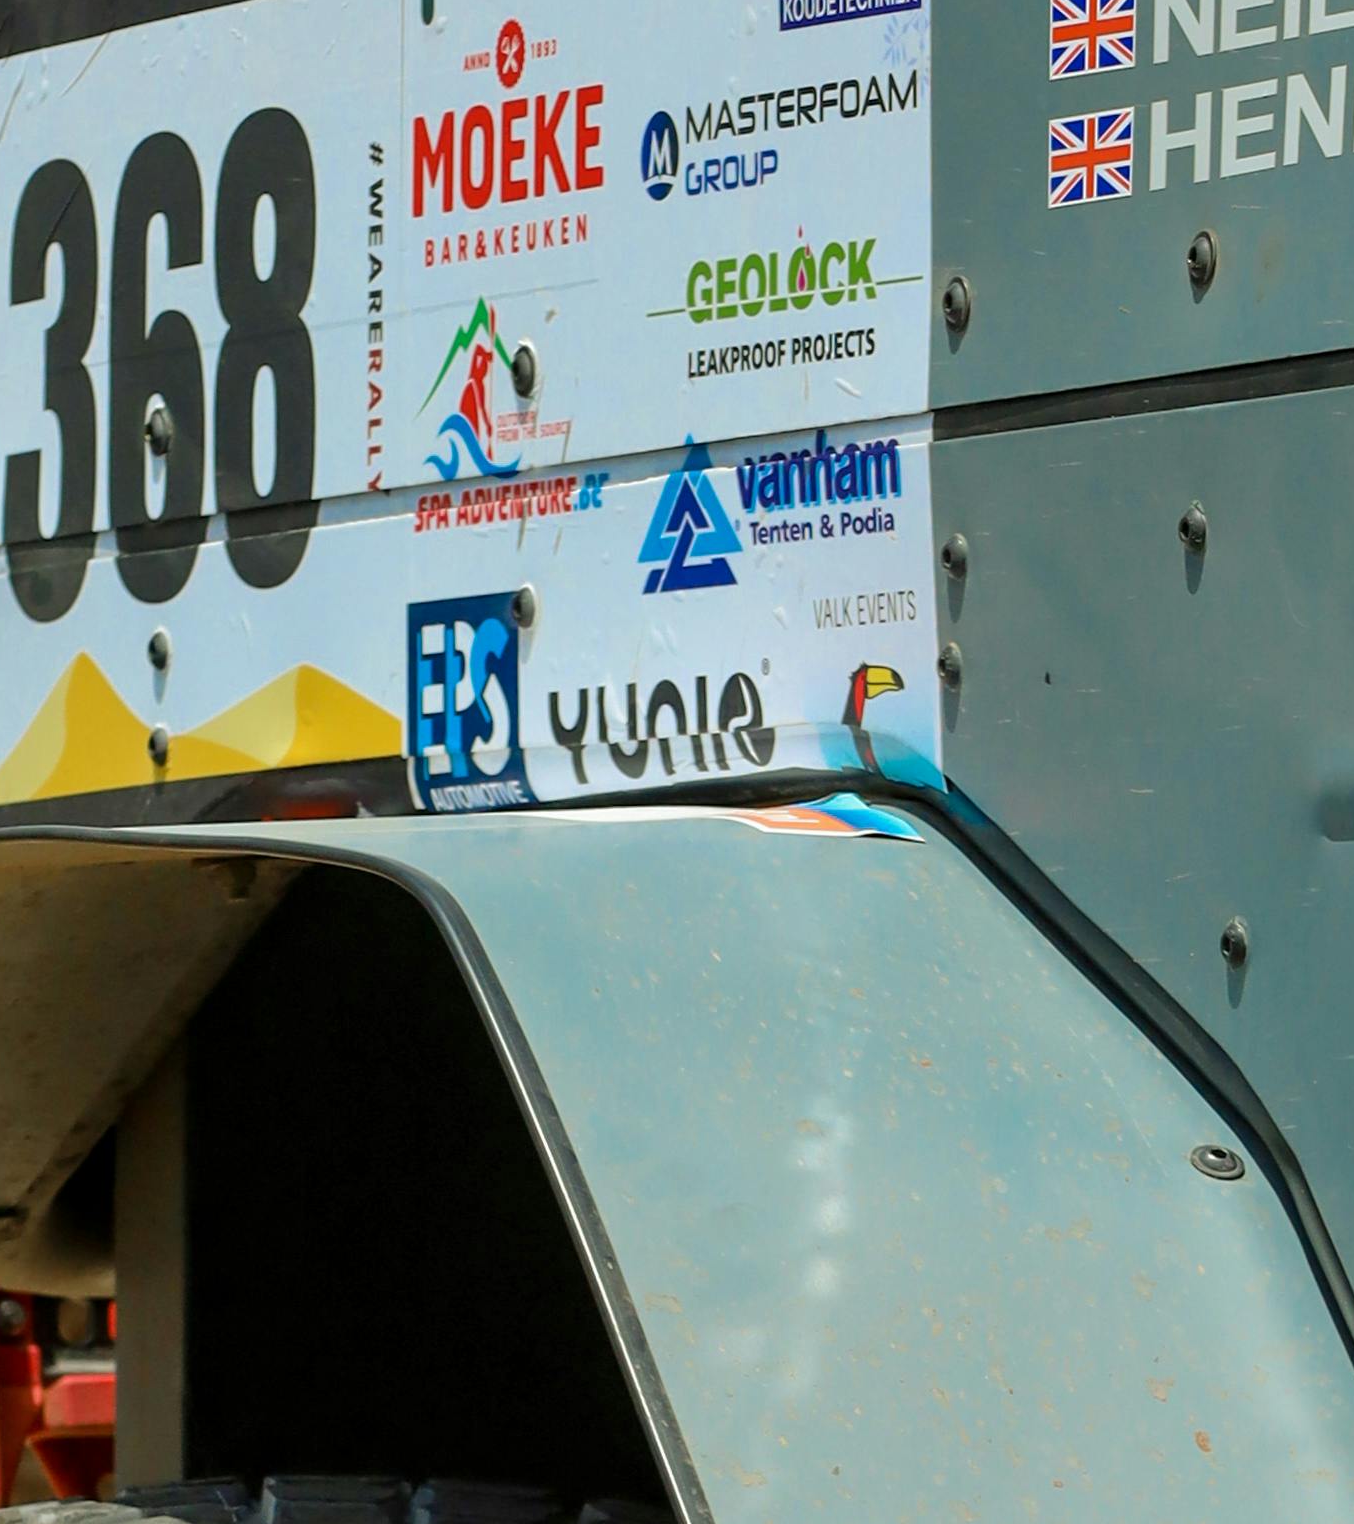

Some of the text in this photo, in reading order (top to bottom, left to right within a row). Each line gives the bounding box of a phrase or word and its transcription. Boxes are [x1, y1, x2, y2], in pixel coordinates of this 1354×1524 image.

[685, 69, 919, 144] MASTERFOAM
[412, 84, 604, 218] MOEKE
[685, 149, 779, 196] GROUP
[686, 238, 877, 324] GEOLOCK
[5, 106, 317, 623] 368
[687, 328, 875, 379] LEAKPROOF PROJECTS
[736, 429, 903, 514] vanham
[414, 490, 453, 533] SPA
[750, 508, 896, 546] Tenten & Podia
[812, 590, 916, 629] VALK EVENTS
[429, 779, 529, 813] AUTOMOTIVE
